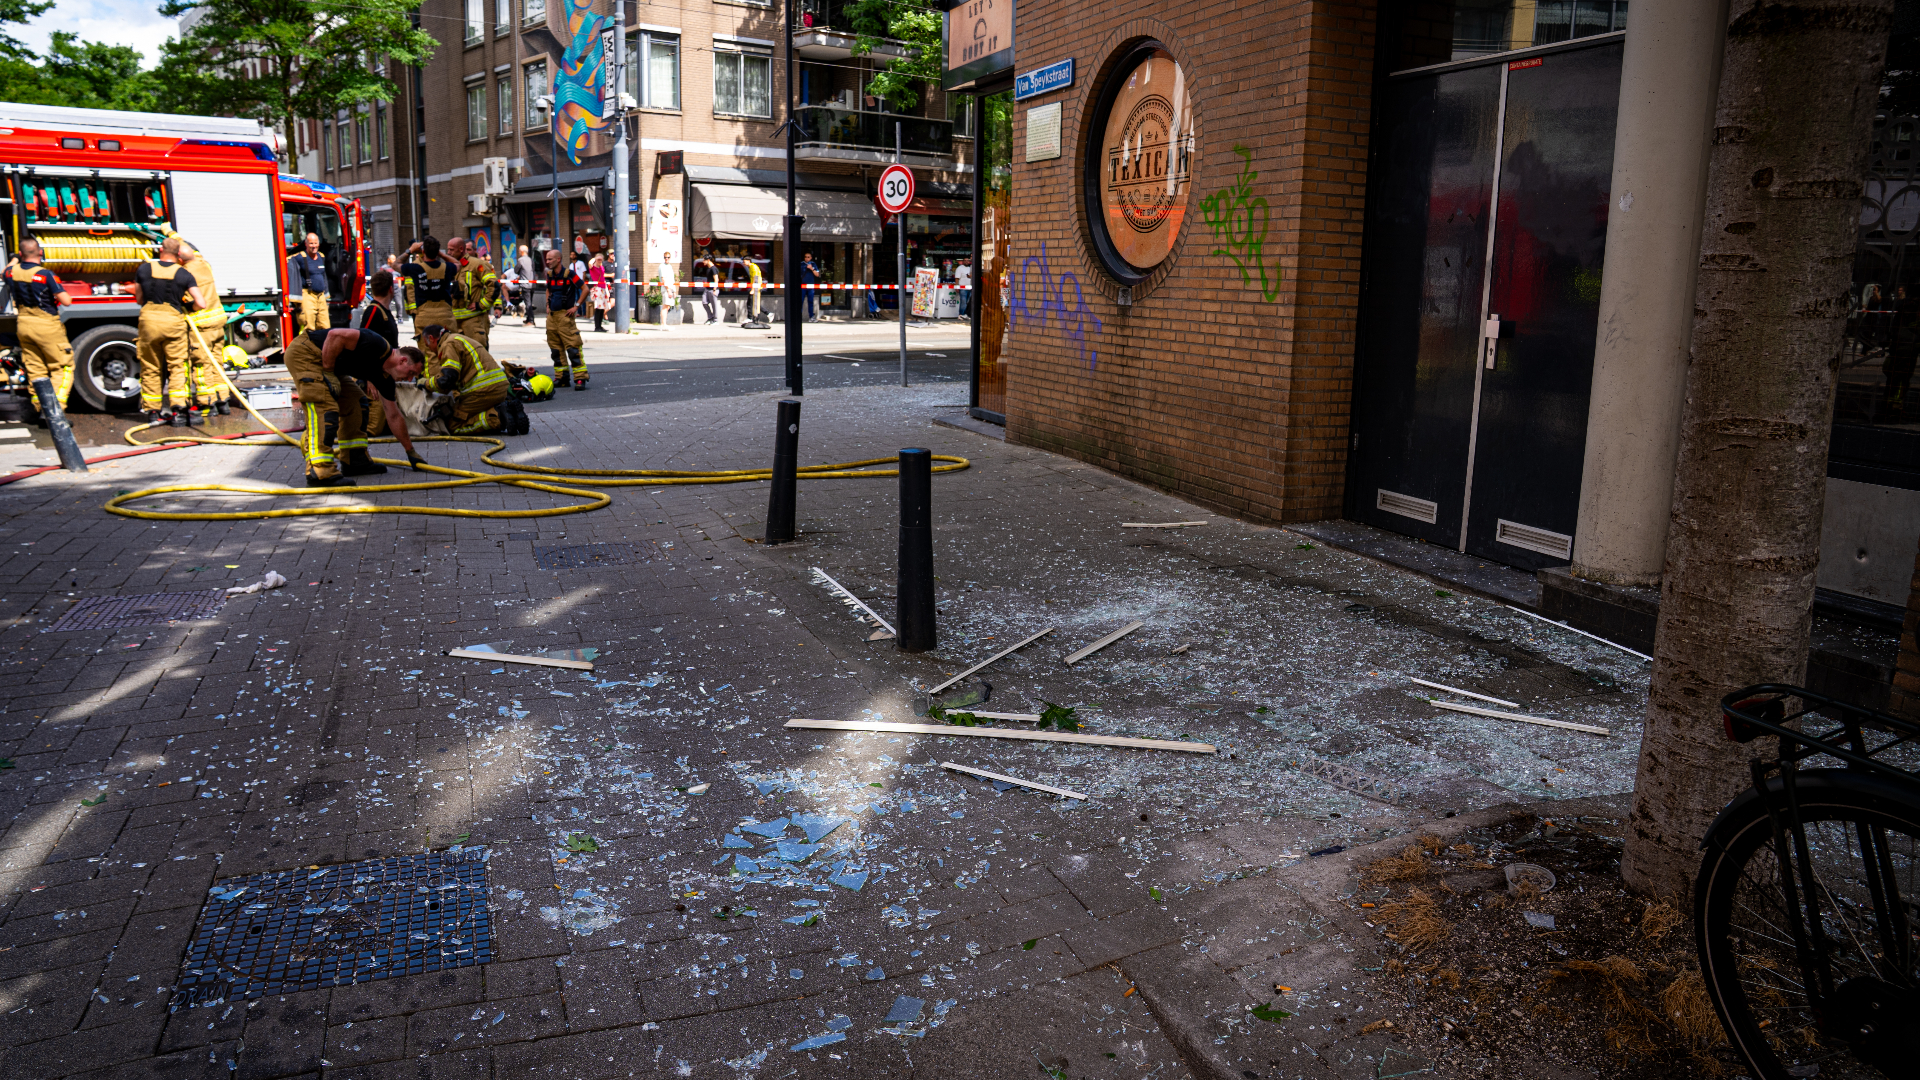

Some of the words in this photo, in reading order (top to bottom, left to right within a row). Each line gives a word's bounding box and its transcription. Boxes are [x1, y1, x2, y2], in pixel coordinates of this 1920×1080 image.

[969, 0, 993, 18] LET'S
[989, 36, 998, 51] IT
[1018, 79, 1029, 94] Van
[1030, 66, 1069, 90] Speykstraat
[1129, 115, 1146, 143] MEXICAN
[1145, 112, 1169, 137] STREETFOOD
[1110, 146, 1188, 182] TEXICAN
[886, 179, 907, 198] 30
[957, 226, 972, 234] Food
[942, 298, 957, 306] Lyca
[264, 874, 443, 908] DRAINAGE
[175, 984, 229, 1006] DRAIN
